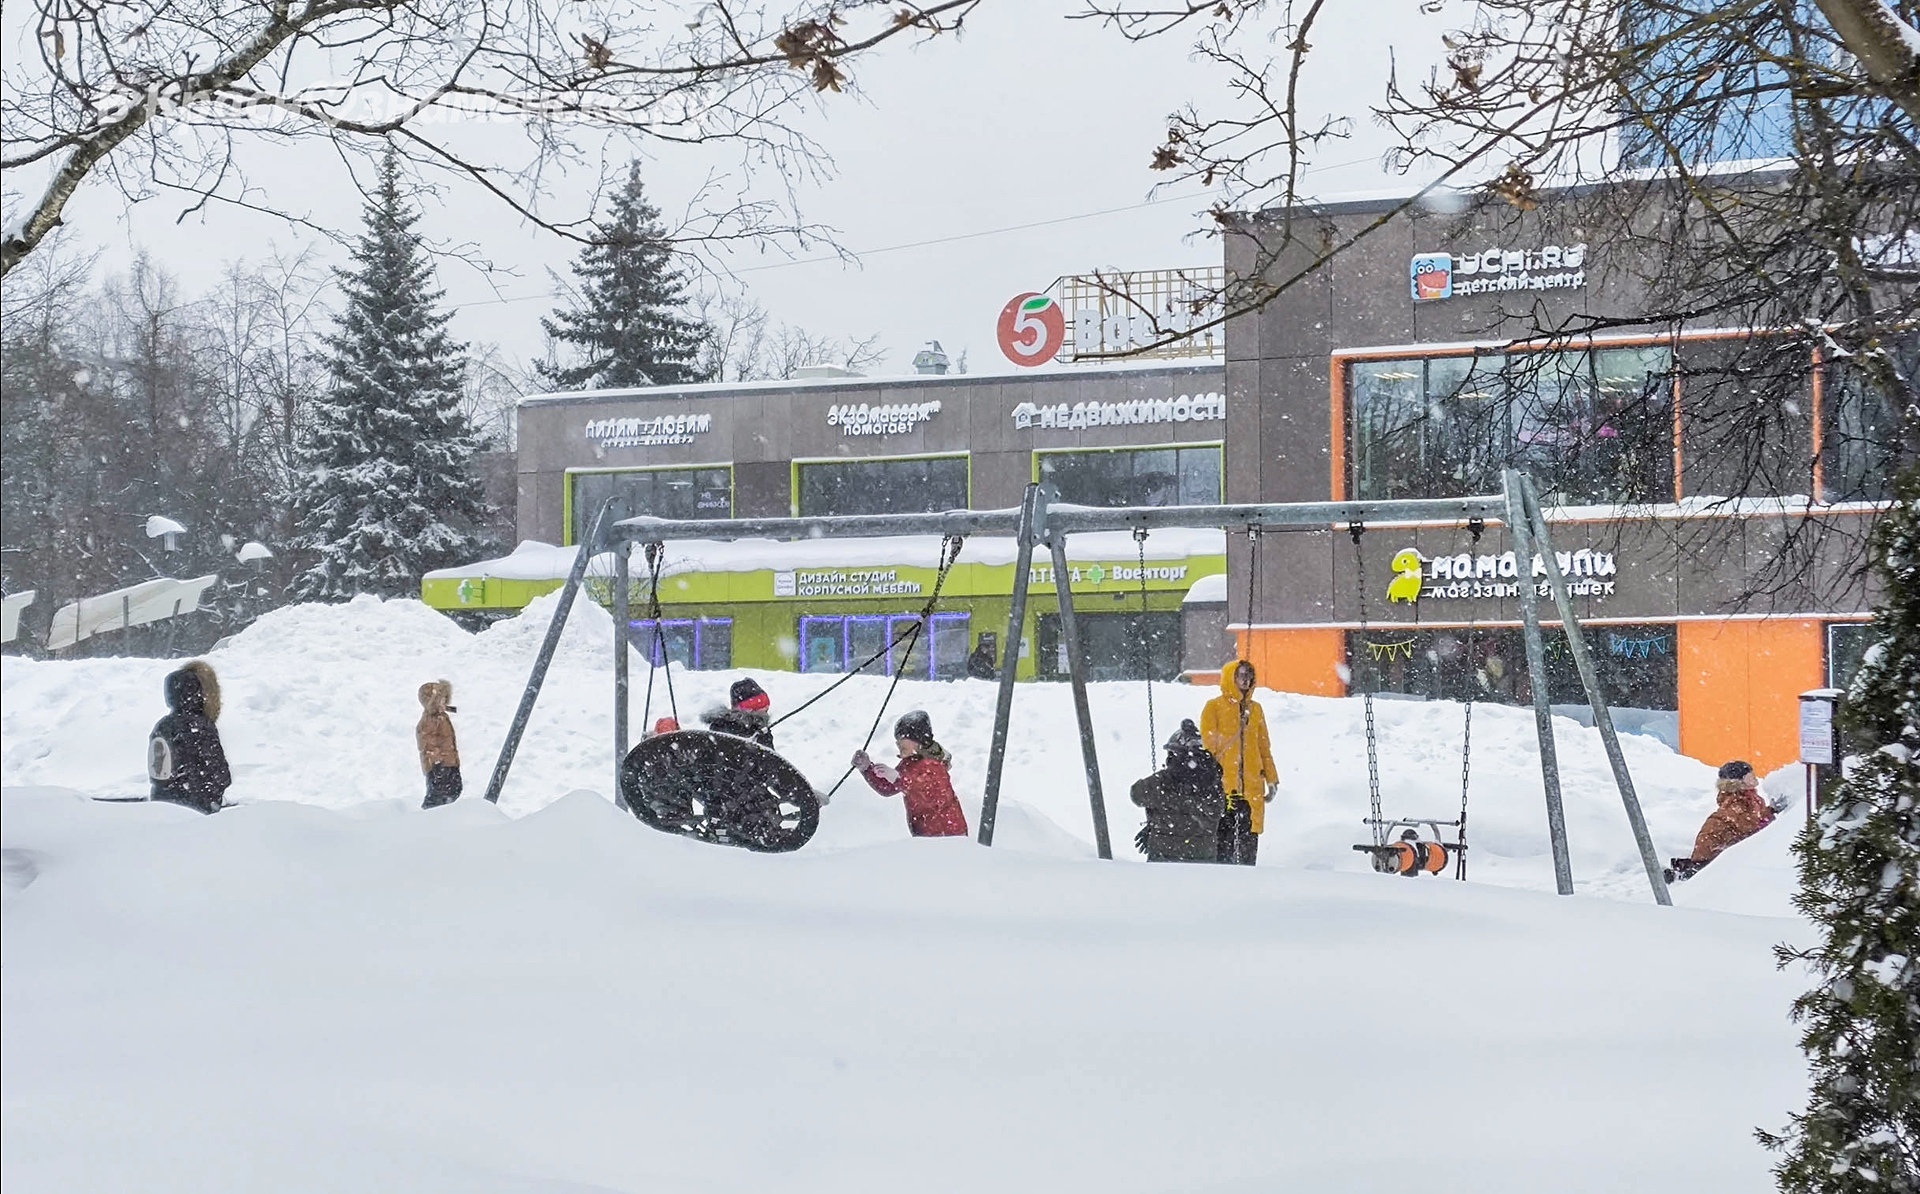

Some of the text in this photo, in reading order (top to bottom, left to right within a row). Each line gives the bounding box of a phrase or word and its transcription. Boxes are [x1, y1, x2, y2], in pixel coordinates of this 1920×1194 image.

[843, 420, 914, 435] помогает
[798, 571, 847, 584] ДИЗАЙН
[850, 570, 897, 582] СТУДИЯ
[1113, 565, 1187, 581] Военторг
[798, 584, 869, 596] КОРПУСНОЙ
[872, 581, 922, 594] МЕБЕЛИ
